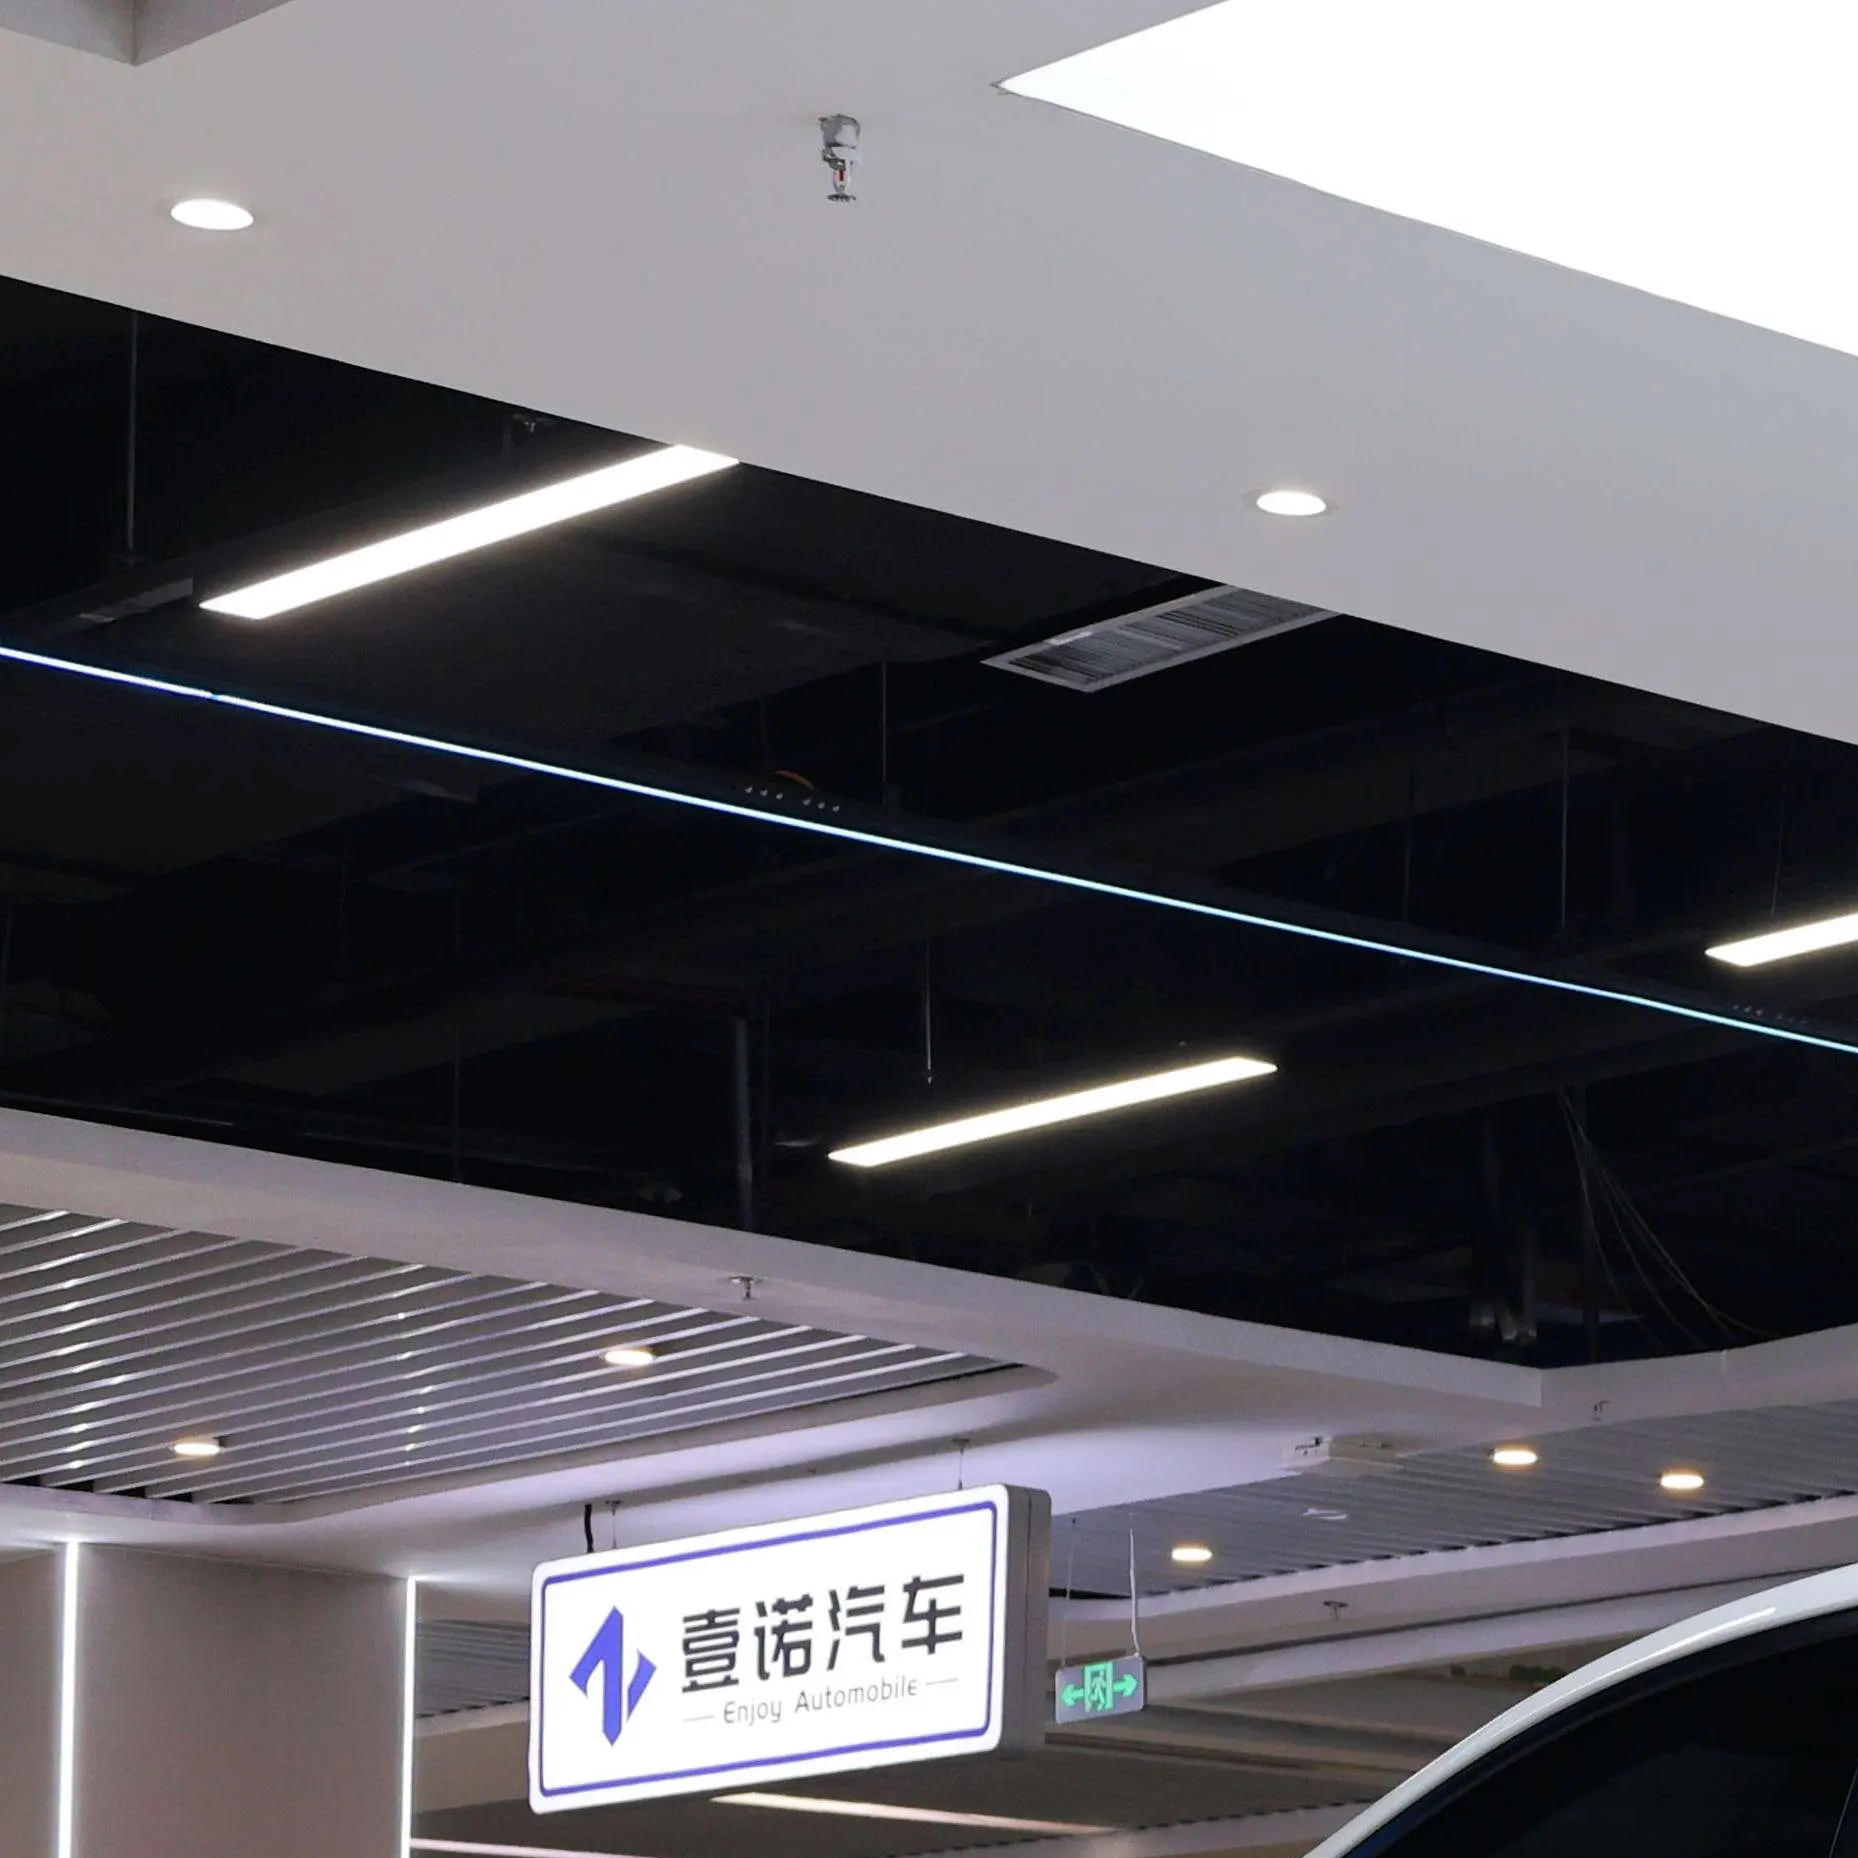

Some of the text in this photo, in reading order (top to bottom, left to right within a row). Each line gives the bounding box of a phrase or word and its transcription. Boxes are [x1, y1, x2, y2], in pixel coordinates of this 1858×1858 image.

[682, 1574, 964, 1693] 壹诺汽车
[724, 1675, 918, 1726] Enjoy Automobile
